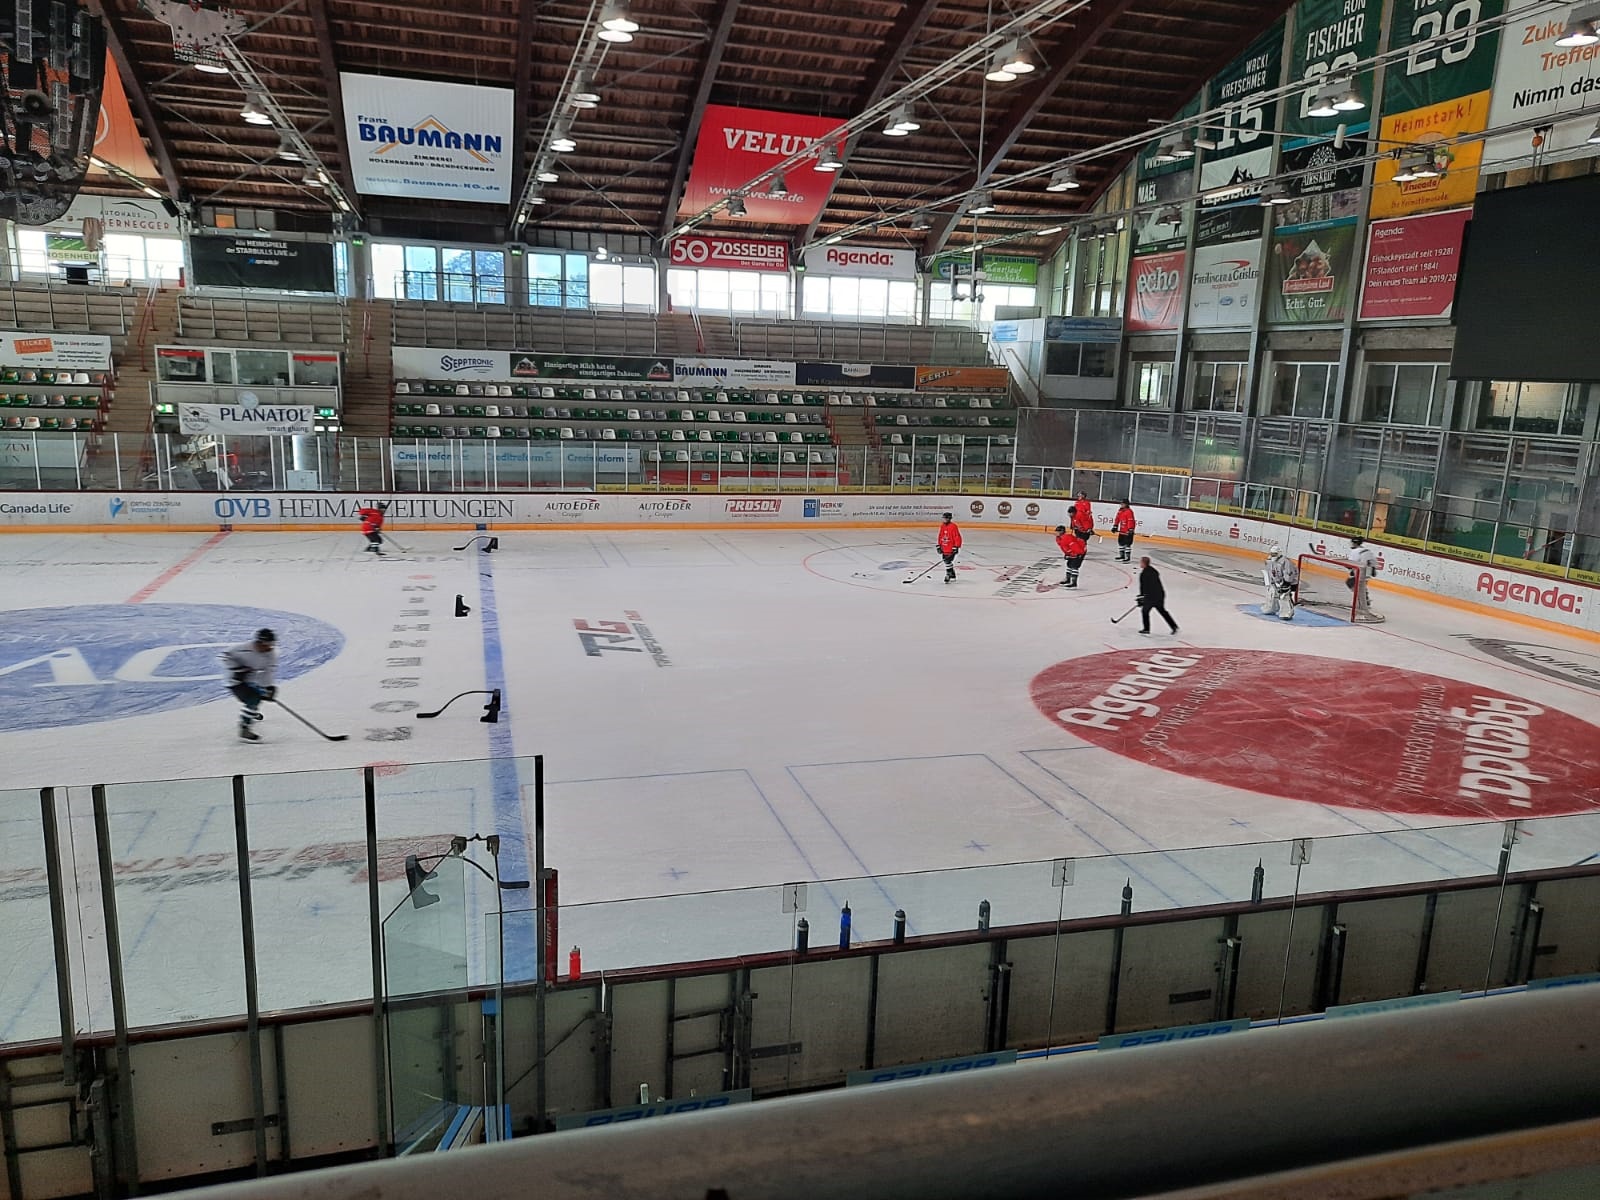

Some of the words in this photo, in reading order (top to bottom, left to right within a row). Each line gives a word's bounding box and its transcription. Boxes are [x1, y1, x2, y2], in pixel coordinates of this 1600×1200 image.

[1305, 13, 1365, 61] FISCHER
[1406, 0, 1482, 76] 29
[1221, 71, 1266, 99] KRETSCHMER
[1513, 85, 1564, 109] Nimm
[358, 115, 388, 124] Franz
[1217, 91, 1264, 150] 15
[358, 124, 502, 153] BAUMANN
[723, 128, 822, 159] VELUX
[1374, 226, 1405, 238] Agenda:
[672, 240, 709, 262] 50
[712, 241, 785, 260] ZOSSEDER
[826, 248, 894, 266] Agenda:
[1137, 267, 1180, 294] echo
[440, 354, 494, 372] SEPPTRONIC
[675, 366, 728, 376] BAUMANN
[220, 407, 309, 422] PLANATOL
[0, 503, 46, 514] Canada
[48, 503, 72, 514] Life
[214, 498, 272, 518] OVB
[572, 501, 600, 510] EDER
[665, 501, 692, 510] EDER
[727, 500, 778, 512] PROSOL
[1182, 523, 1224, 537] Sparkasse
[1388, 563, 1431, 583] Sparkasse
[1476, 572, 1583, 614] Agenda:
[1056, 650, 1204, 732] Agenda:
[1451, 694, 1551, 809] Agenda:
